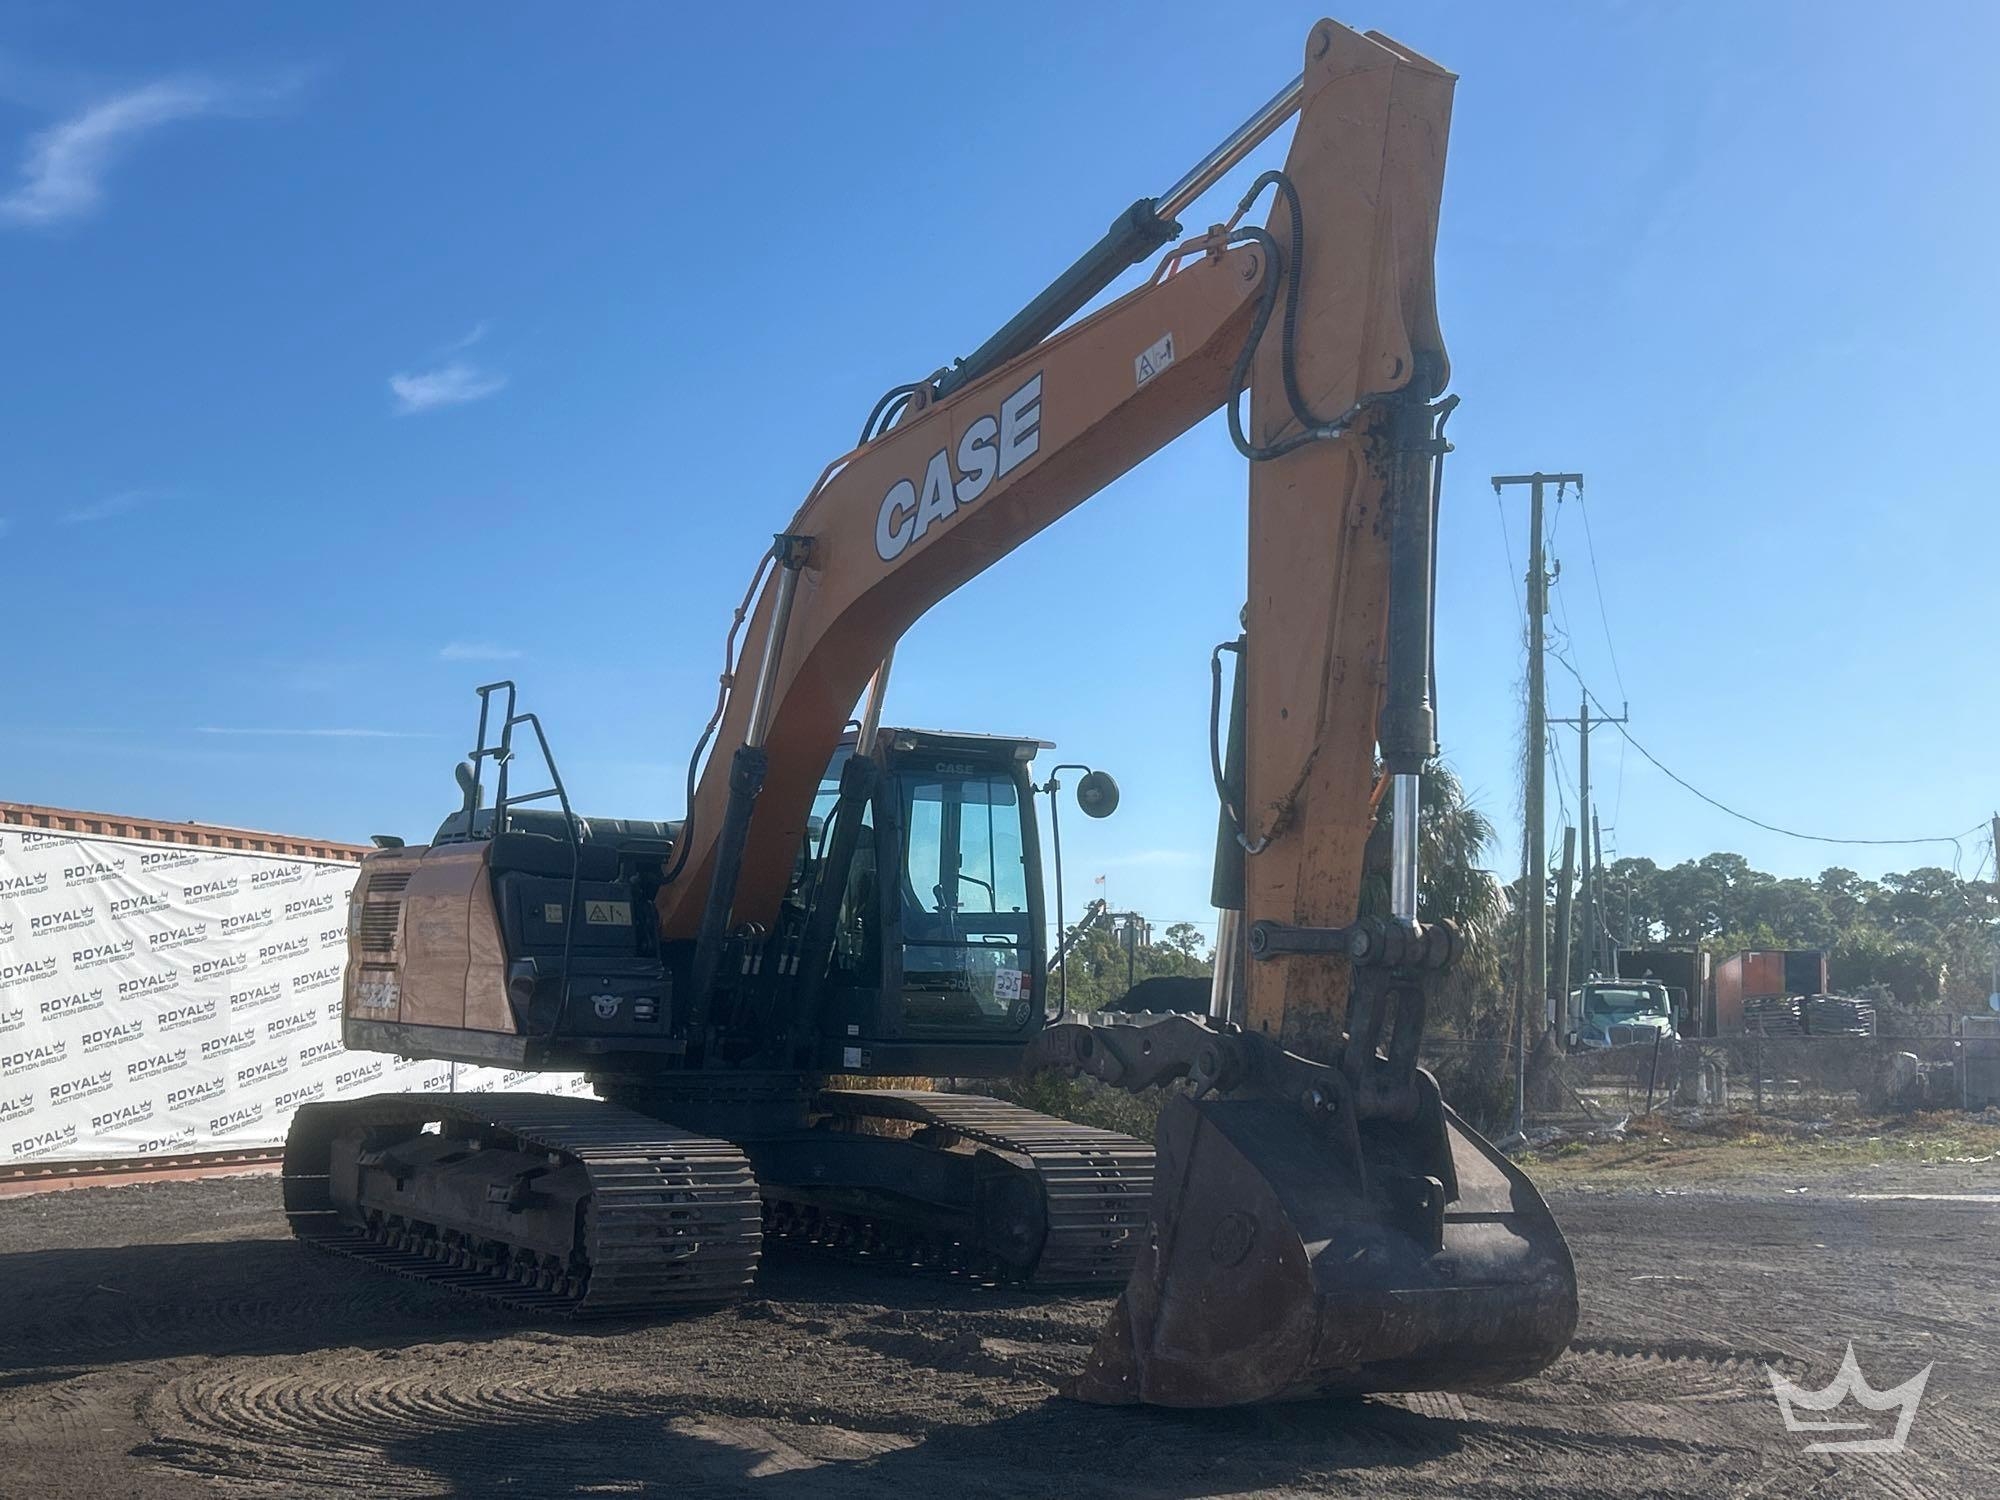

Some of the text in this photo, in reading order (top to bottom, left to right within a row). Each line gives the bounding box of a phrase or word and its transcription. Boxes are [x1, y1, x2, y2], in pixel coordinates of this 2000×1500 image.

[874, 369, 1044, 562] CASE
[935, 762, 975, 775] CASE
[23, 842, 58, 852] AUCTION
[141, 850, 187, 865] ROYAL
[64, 862, 113, 879] ROYAL
[142, 862, 173, 873] AUCTION
[252, 868, 291, 882] ROYAL
[0, 876, 33, 891] YAL
[183, 881, 227, 897] ROYAL
[253, 879, 280, 890] AUCTION
[0, 892, 19, 900] TION
[110, 894, 157, 912] ROYAL
[185, 893, 215, 904] AUCTION
[286, 896, 322, 913] ROYAL
[31, 909, 80, 928] ROYAL
[112, 907, 144, 920] AUCTION
[221, 912, 262, 928] ROYAL
[286, 910, 312, 920] AUCTION
[32, 924, 67, 937] AUCTION
[150, 927, 194, 944] ROYAL
[223, 925, 250, 936] AUCTION
[321, 927, 349, 941] ROYA
[73, 943, 121, 962] ROYAL
[152, 939, 182, 952] AUCTION
[260, 940, 294, 958] ROYAL
[75, 959, 108, 970] AUCTION
[192, 957, 235, 975] ROYAL
[261, 953, 288, 964] AUCTION
[0, 977, 28, 989] UCTION
[119, 974, 163, 993] ROYAL
[194, 970, 224, 982] AUCTION
[293, 968, 330, 986] ROYAL
[120, 989, 152, 1001] AUCTION
[230, 986, 270, 1004] ROYAL
[295, 982, 320, 993] AUCTION
[40, 992, 90, 1014] ROYAL
[232, 1000, 259, 1012] AUCTION
[42, 1008, 76, 1021] AUCTION
[158, 1005, 203, 1024] ROYAL
[160, 1020, 192, 1032] AUCTION
[268, 1013, 305, 1032] ROYAL
[82, 1025, 130, 1046] ROYAL
[269, 1028, 296, 1039] AUCTION
[84, 1041, 117, 1053] AUCTION
[201, 1032, 244, 1053] ROYAL
[300, 1040, 337, 1060] ROYAL
[2, 1046, 53, 1068] ROYAL
[203, 1048, 233, 1060] AUCTION
[301, 1055, 327, 1067] AUCTION
[3, 1063, 39, 1076] AUCTION
[128, 1054, 174, 1074] ROYAL
[238, 1061, 278, 1081] ROYAL
[129, 1070, 161, 1082] AUCTION
[239, 1076, 266, 1088] AUCTION
[336, 1066, 372, 1084] ROYAL
[424, 1073, 452, 1089] ROYA
[50, 1076, 99, 1098] ROYAL
[168, 1082, 213, 1103] ROYAL
[338, 1079, 362, 1092] AUCTION
[52, 1092, 86, 1106] AUCTION
[275, 1086, 314, 1107] ROYAL
[169, 1098, 200, 1111] AUCTION
[92, 1106, 140, 1128] ROYAL
[210, 1108, 252, 1130] ROYAL
[95, 1121, 127, 1136] AUCTION
[212, 1124, 240, 1136] AUCTION
[12, 1130, 63, 1154] ROYAL
